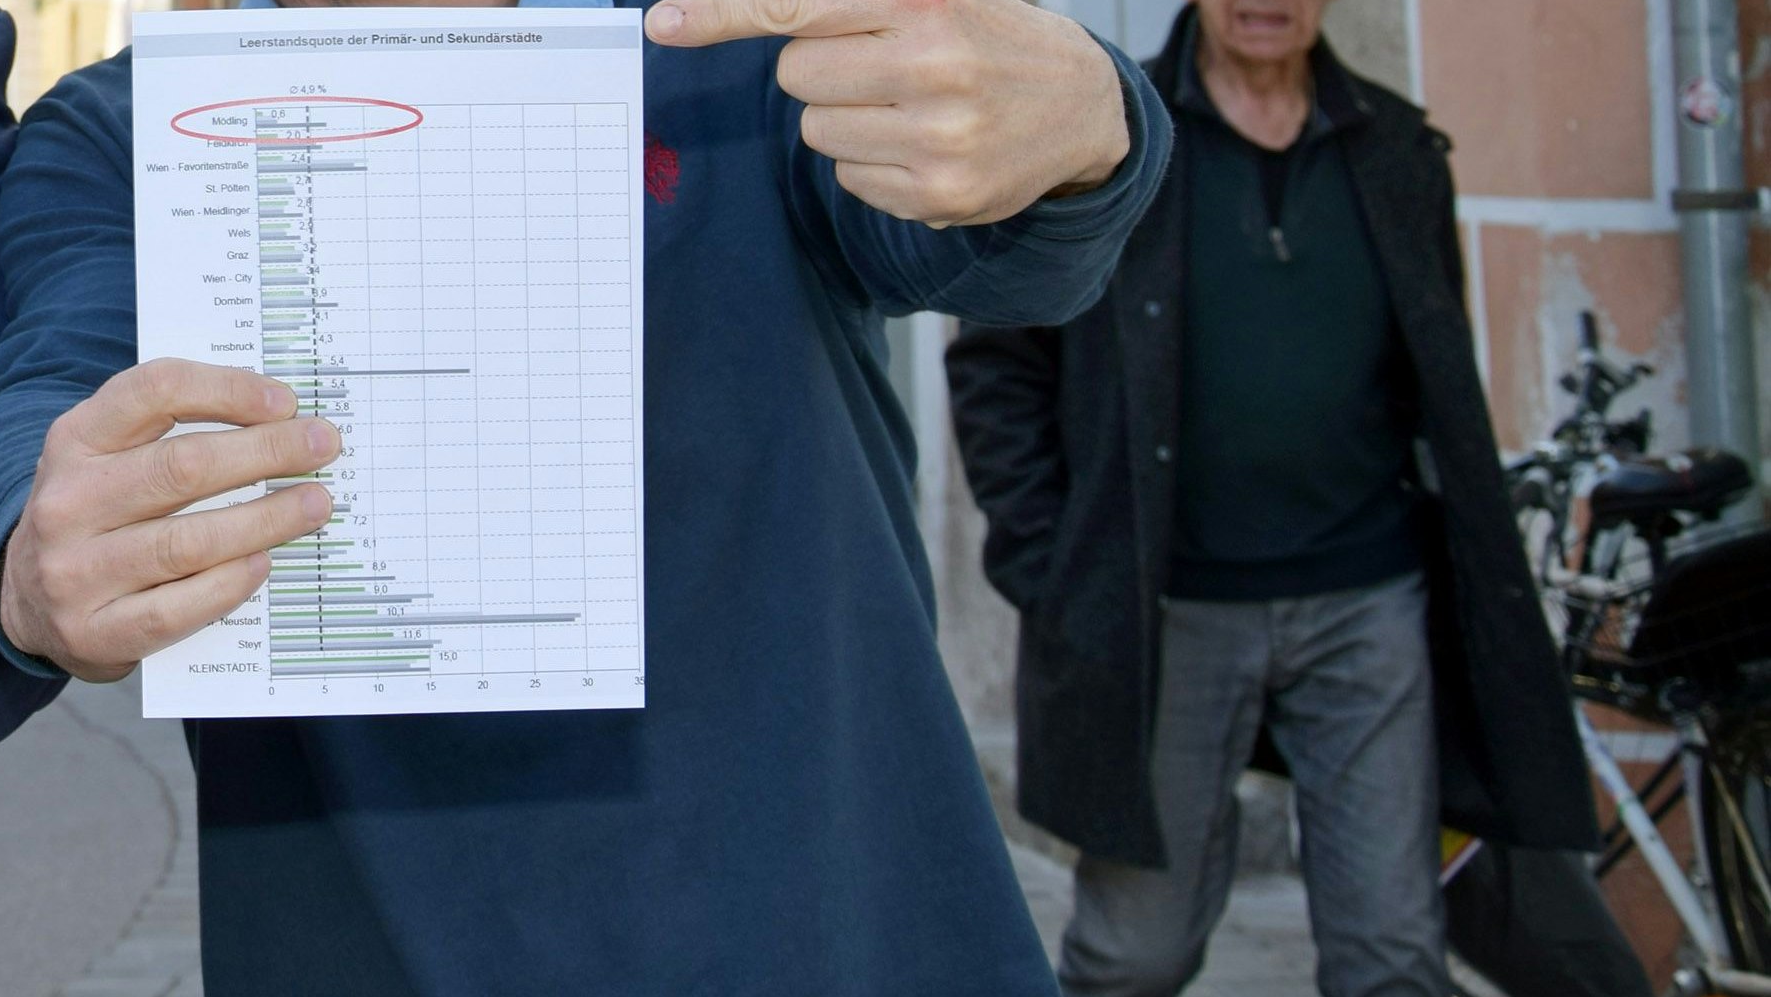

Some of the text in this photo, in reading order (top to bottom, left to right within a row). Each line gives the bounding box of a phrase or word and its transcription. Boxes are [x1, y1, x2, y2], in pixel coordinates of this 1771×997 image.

[239, 31, 542, 49] Leerstandsquote der Primär- und Sekundärstädte
[300, 85, 315, 95] 4,9
[317, 84, 327, 94] %
[271, 109, 286, 119] 0,6
[291, 153, 306, 164] 2,4
[146, 162, 170, 173] Wien
[172, 207, 195, 217] Wien
[228, 229, 251, 238] Wels
[227, 251, 249, 261] Graz
[203, 274, 226, 284] Wien
[235, 273, 253, 284] City
[235, 319, 254, 328] Linz
[319, 334, 334, 344] 4,3
[211, 342, 255, 352] Innsbruck
[330, 356, 345, 367] 5,4
[331, 379, 346, 389] 5,4
[335, 402, 350, 412] 5,8
[341, 470, 356, 481] 6,2
[344, 493, 358, 503] 6,4
[353, 516, 367, 526] 7,2
[363, 539, 377, 549] 8,1
[372, 562, 387, 573] 8,9
[374, 585, 388, 595] 9,0
[387, 607, 405, 618] 10,1
[220, 615, 262, 626] Neustadt
[403, 630, 422, 640] 11,6
[238, 640, 262, 651] Steyr
[439, 651, 458, 662] 15,0
[269, 686, 276, 695] 0
[322, 684, 329, 694] 5
[373, 683, 384, 693] 10
[426, 682, 436, 691] 15
[477, 680, 489, 690] 20
[530, 679, 541, 689] 25
[582, 678, 594, 687] 30
